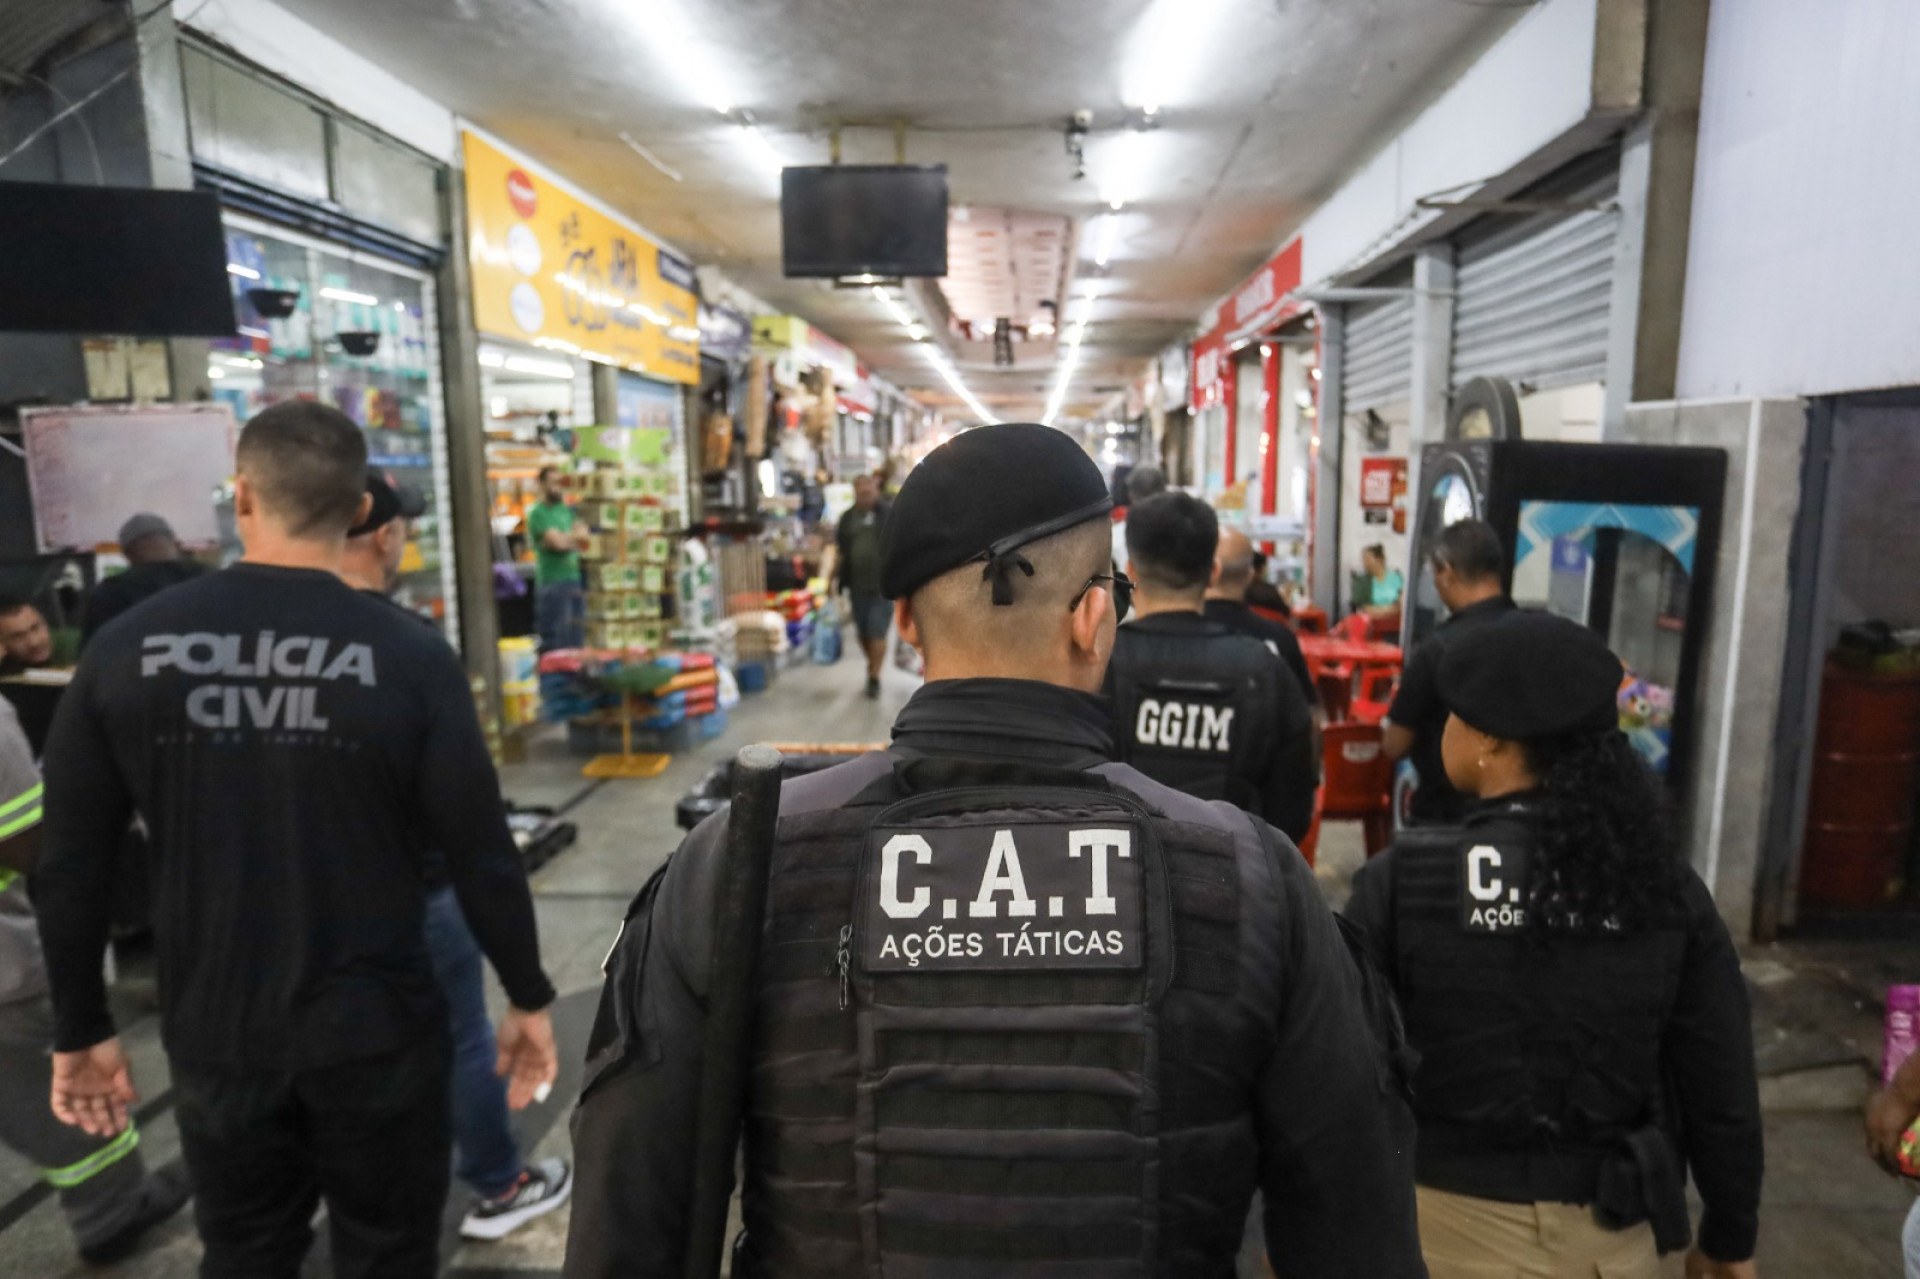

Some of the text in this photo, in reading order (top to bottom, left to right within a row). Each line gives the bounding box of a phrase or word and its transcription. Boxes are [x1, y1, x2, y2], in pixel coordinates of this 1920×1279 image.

[186, 683, 329, 731] CIVIL
[1135, 698, 1235, 752] GGIM
[879, 828, 1131, 920] C.A.T
[1469, 903, 1525, 931] AÇÕE
[879, 921, 1124, 967] AÇÕES TÁTICAS
